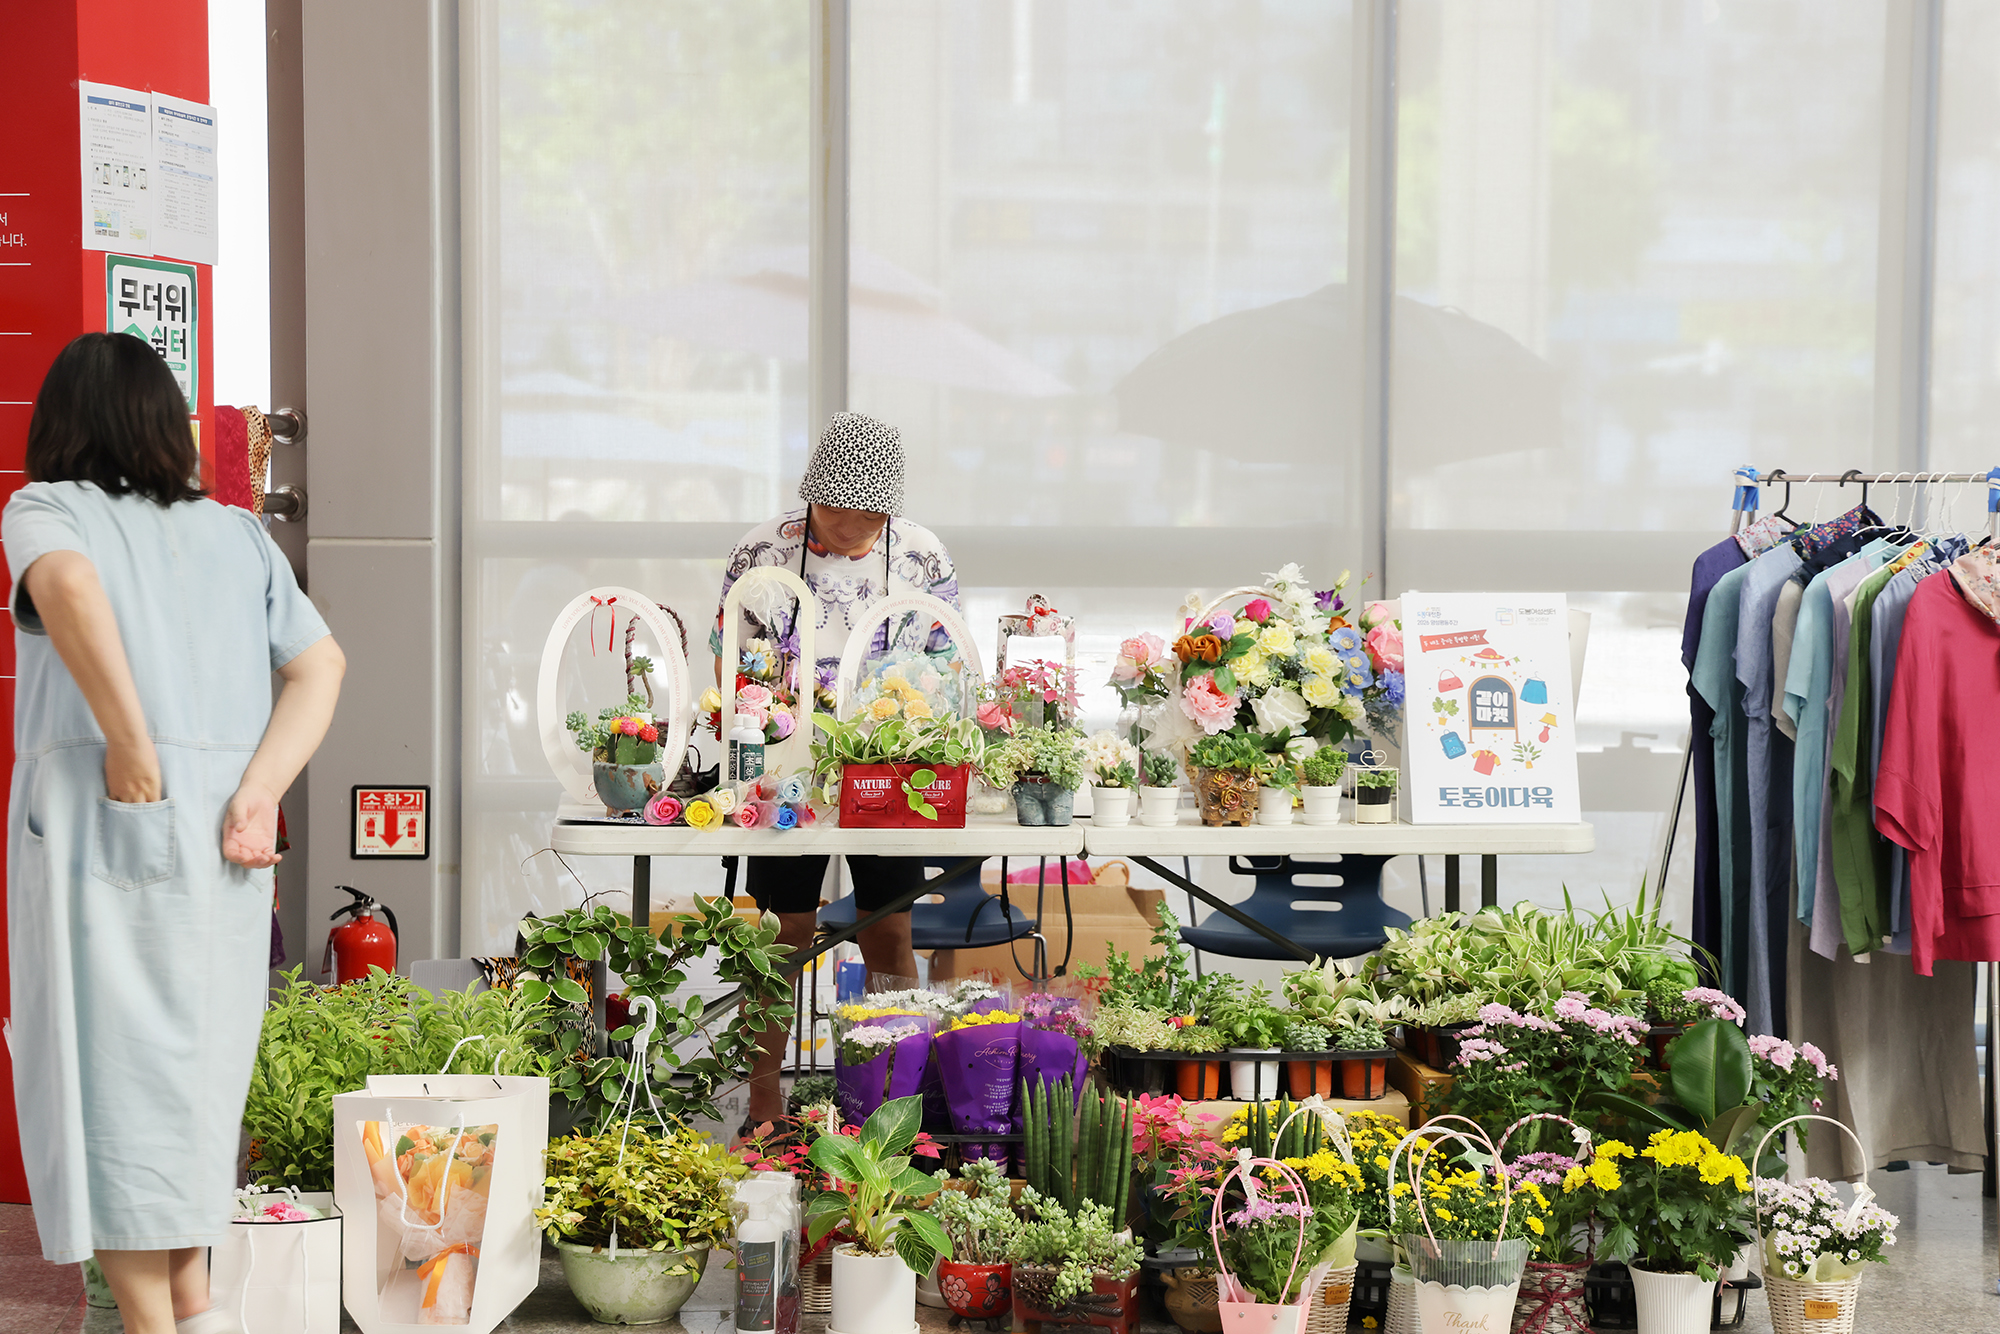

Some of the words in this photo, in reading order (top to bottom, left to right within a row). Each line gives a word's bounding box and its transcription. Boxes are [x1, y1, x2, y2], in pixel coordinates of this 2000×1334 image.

[0, 233, 28, 248] 니다.
[119, 278, 187, 324] 무더위
[151, 324, 187, 360] 쉼터
[1475, 690, 1509, 707] 같이
[1475, 706, 1509, 723] 마켓
[853, 778, 892, 790] NATURE
[362, 792, 420, 806] 소화기
[1438, 786, 1554, 809] 토동이다육
[1442, 1310, 1490, 1332] Thank
